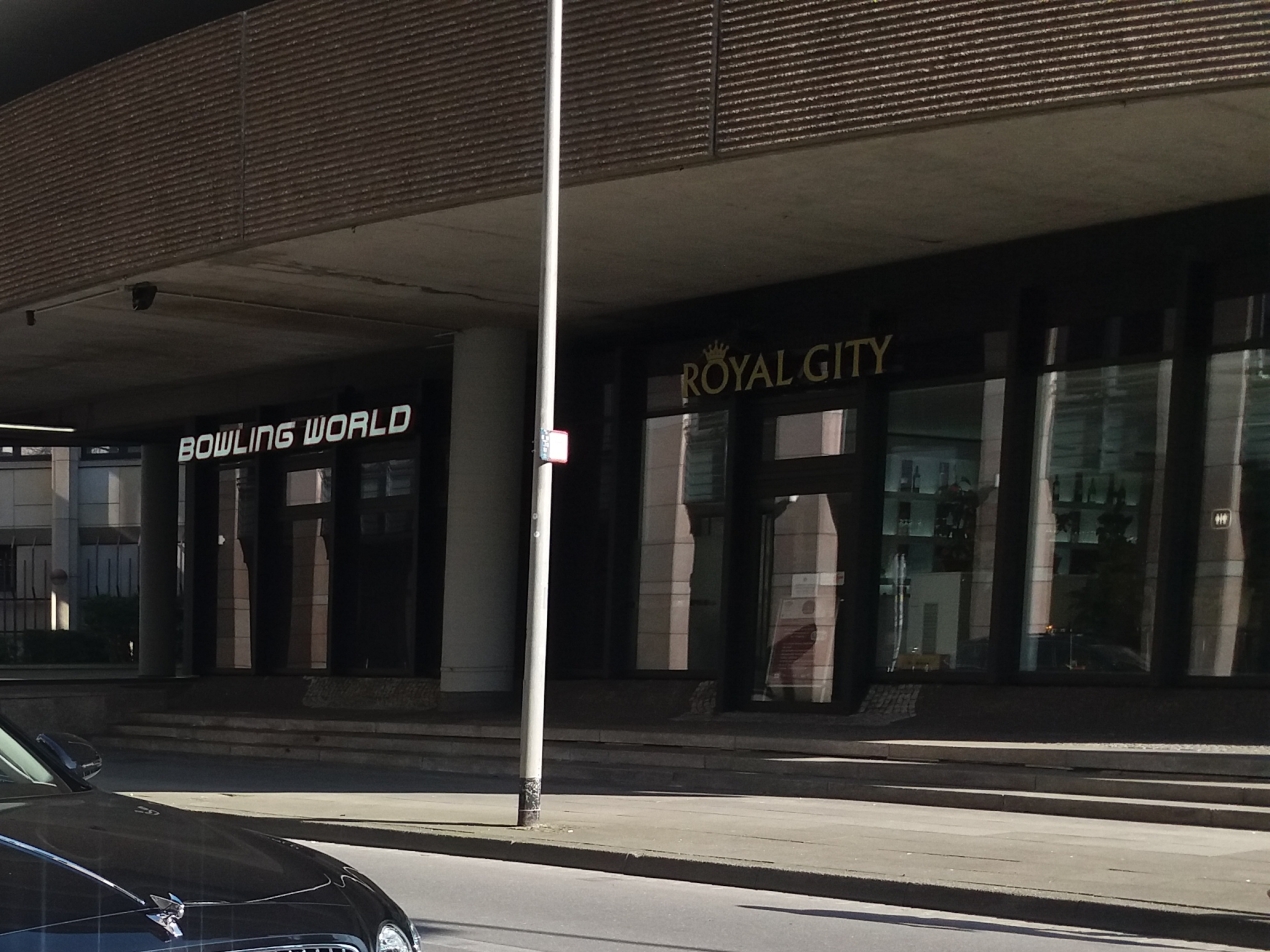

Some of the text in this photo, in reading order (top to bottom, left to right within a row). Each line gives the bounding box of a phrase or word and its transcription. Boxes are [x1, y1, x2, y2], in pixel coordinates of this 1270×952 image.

[683, 350, 792, 396] ROYAL
[177, 404, 412, 463] BOWLING WORLD
